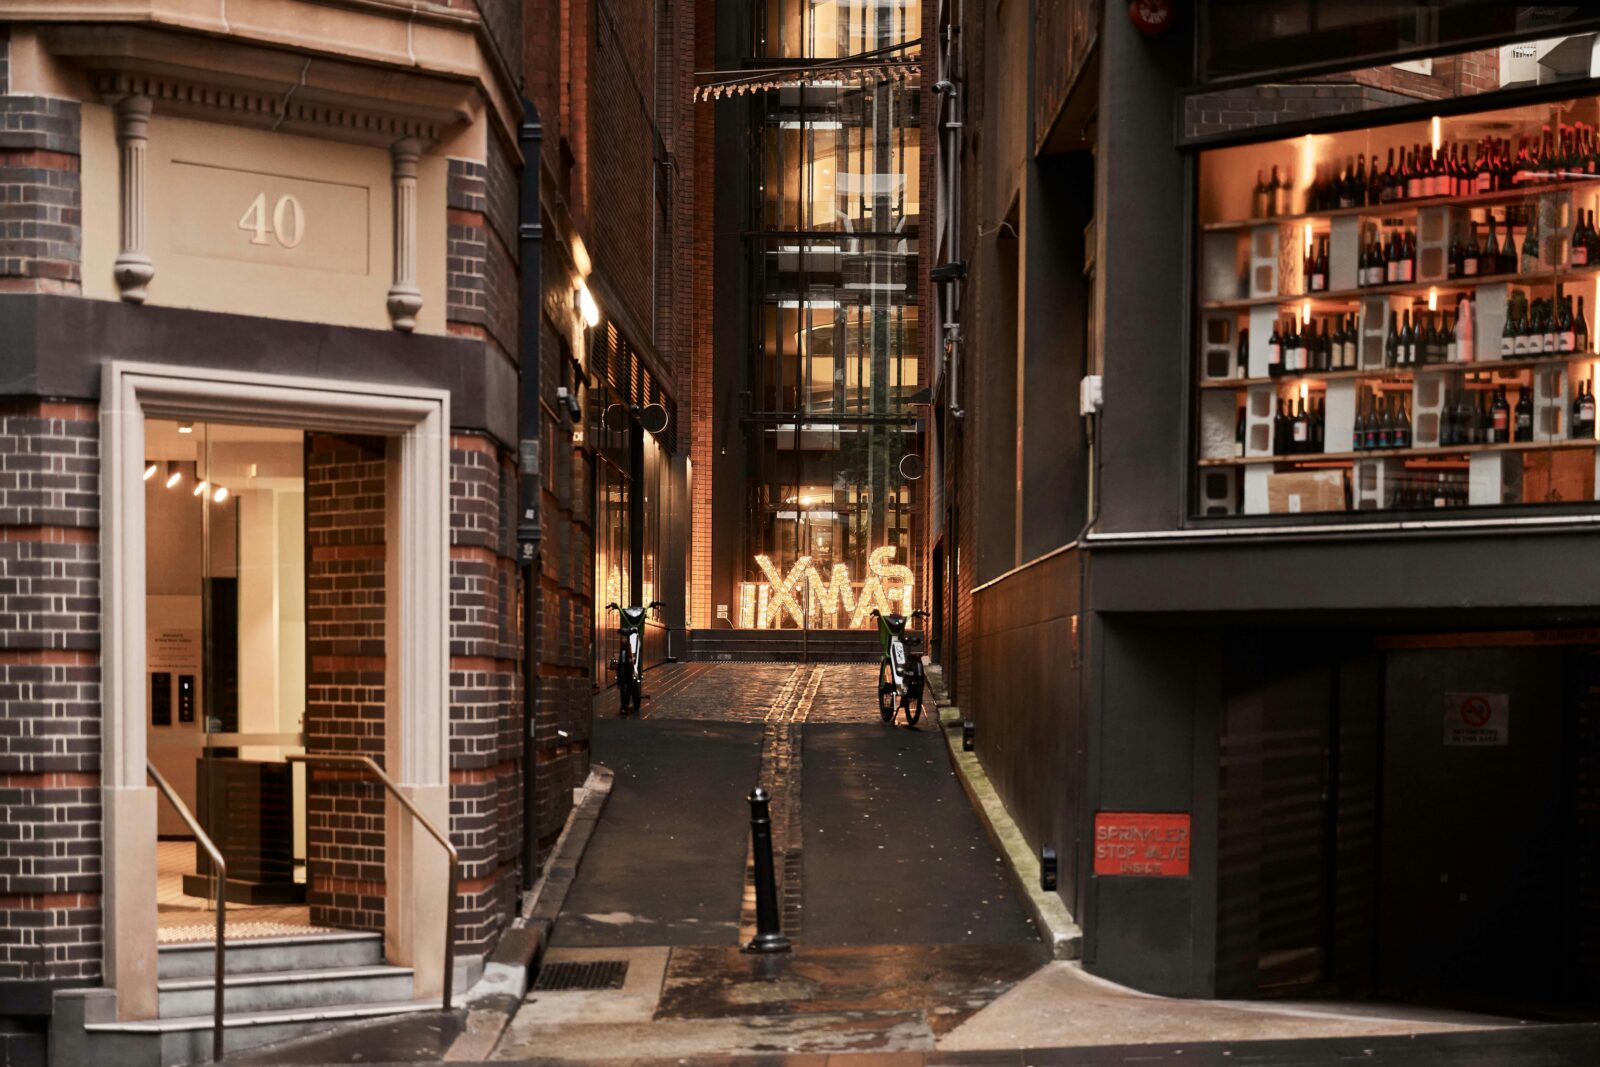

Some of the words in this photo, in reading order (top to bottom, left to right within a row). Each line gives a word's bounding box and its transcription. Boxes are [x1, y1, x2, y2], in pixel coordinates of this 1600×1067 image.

[238, 192, 305, 249] 40
[754, 545, 915, 629] XMAS
[1096, 844, 1137, 860] STOP
[1097, 826, 1188, 843] SPRINKLER
